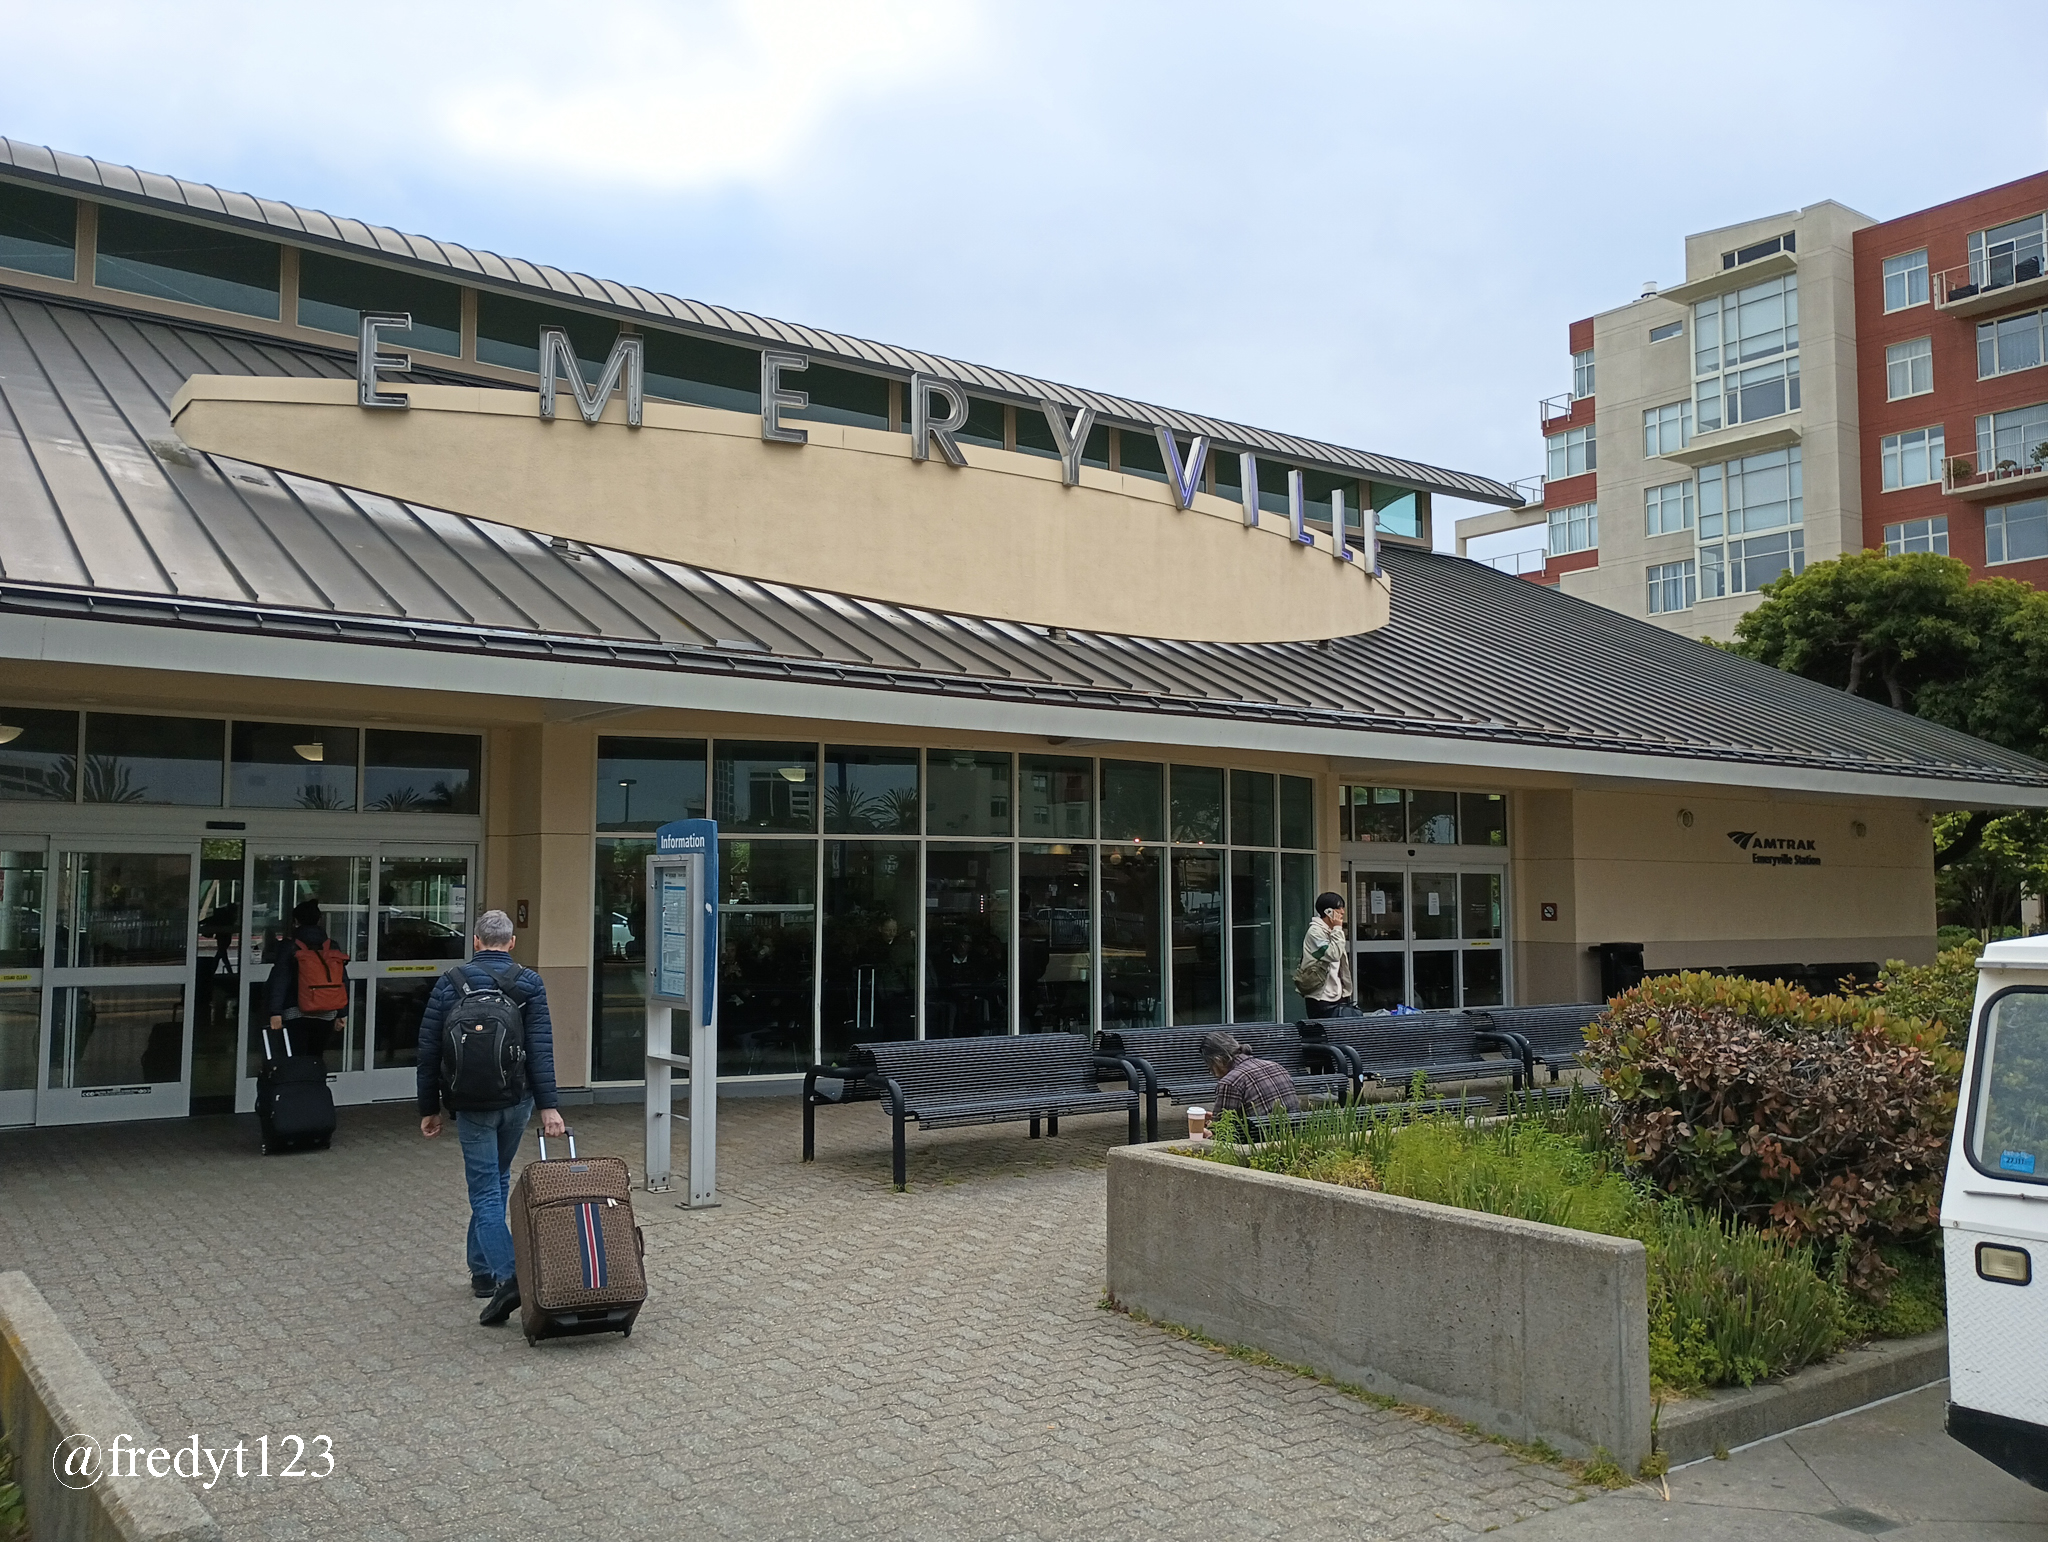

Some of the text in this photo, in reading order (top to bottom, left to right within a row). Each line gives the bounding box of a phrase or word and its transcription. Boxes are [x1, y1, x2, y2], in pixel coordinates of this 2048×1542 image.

[359, 310, 1382, 578] EMERYVILLE
[661, 833, 705, 849] Information
[1752, 838, 1816, 850] AMTRAK
[1752, 853, 1821, 866] Emeryville Station
